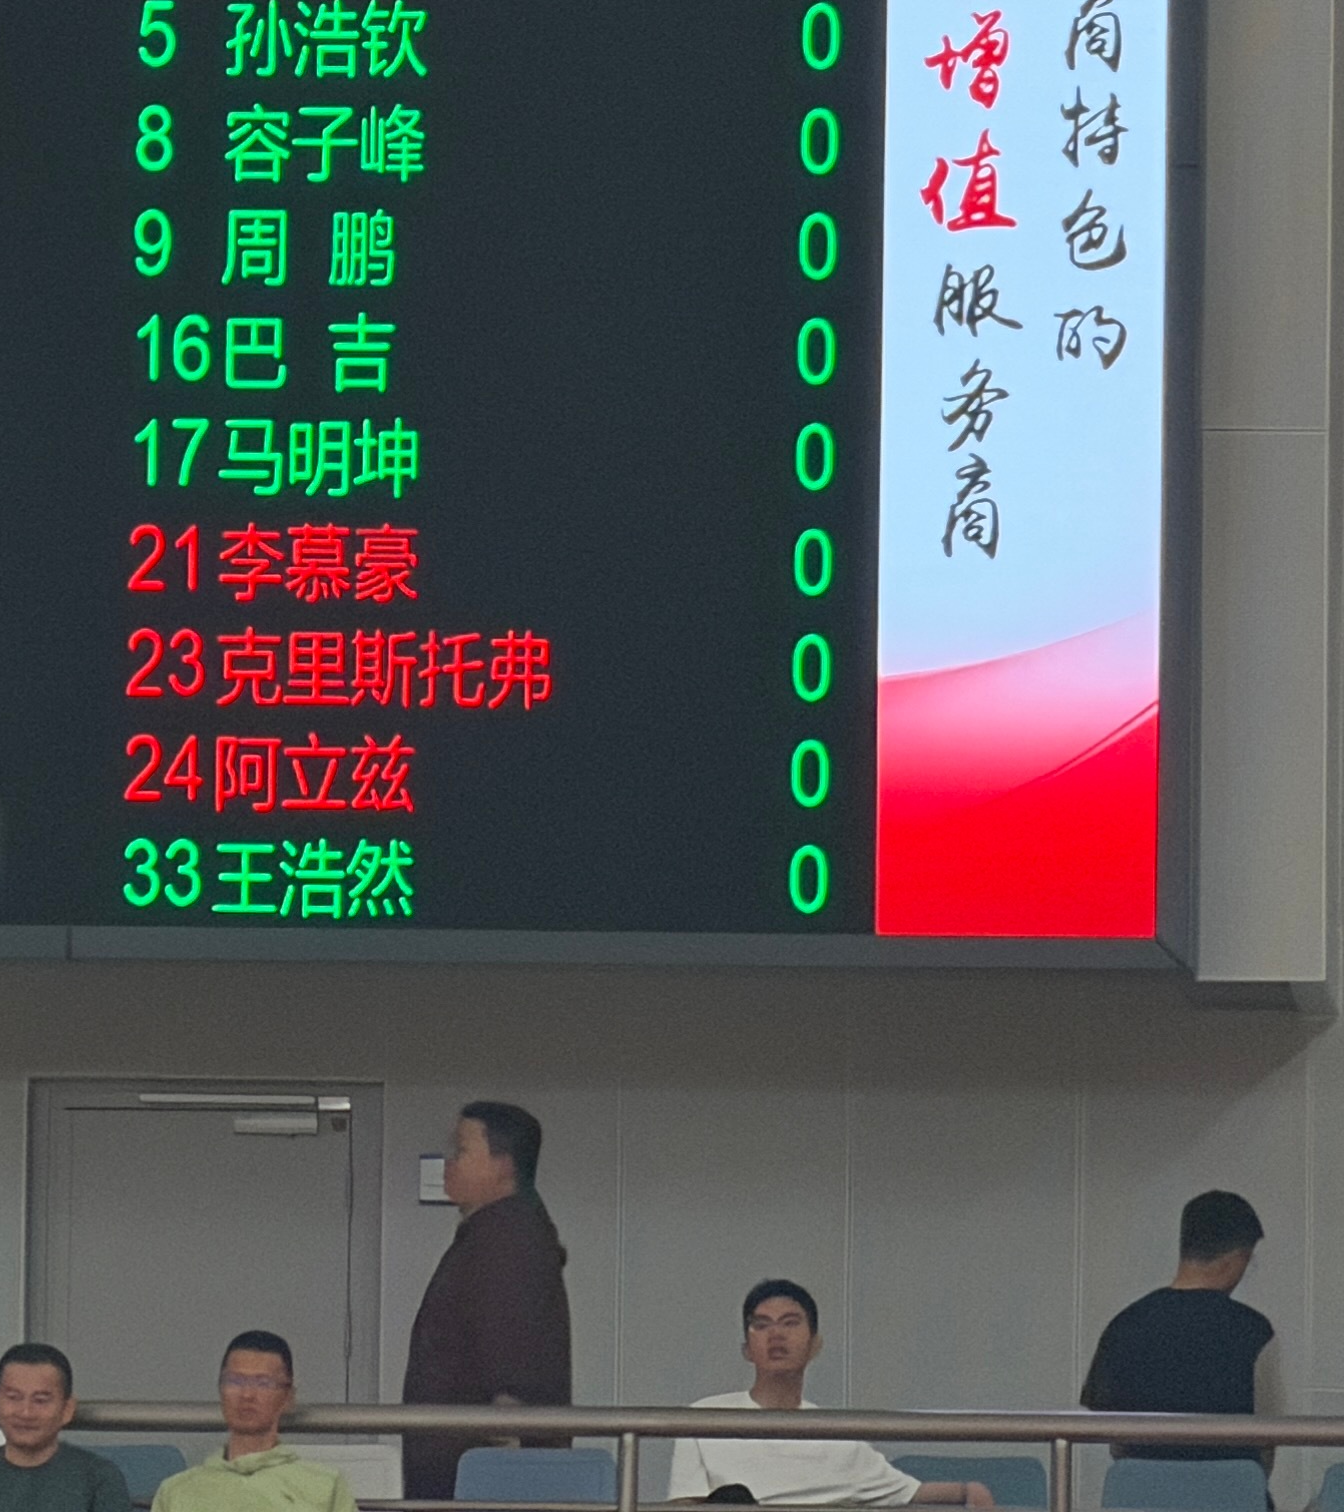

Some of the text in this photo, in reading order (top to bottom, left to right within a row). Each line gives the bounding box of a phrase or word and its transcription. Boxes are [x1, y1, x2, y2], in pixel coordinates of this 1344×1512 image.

[139, 0, 840, 78] 5 孙浩钦 0
[136, 103, 839, 183] 8 容子峰 0
[134, 209, 172, 276] 9
[799, 212, 837, 280] 0
[137, 314, 210, 381] 16
[798, 318, 835, 385] 0
[135, 417, 834, 498] 17 马明坤 0
[128, 522, 832, 604] 21 李慕豪 0
[126, 626, 831, 710] 23 克里斯托弗 0
[124, 732, 829, 812] 24 阿立兹 0
[123, 838, 828, 919] 33 王浩然 0
